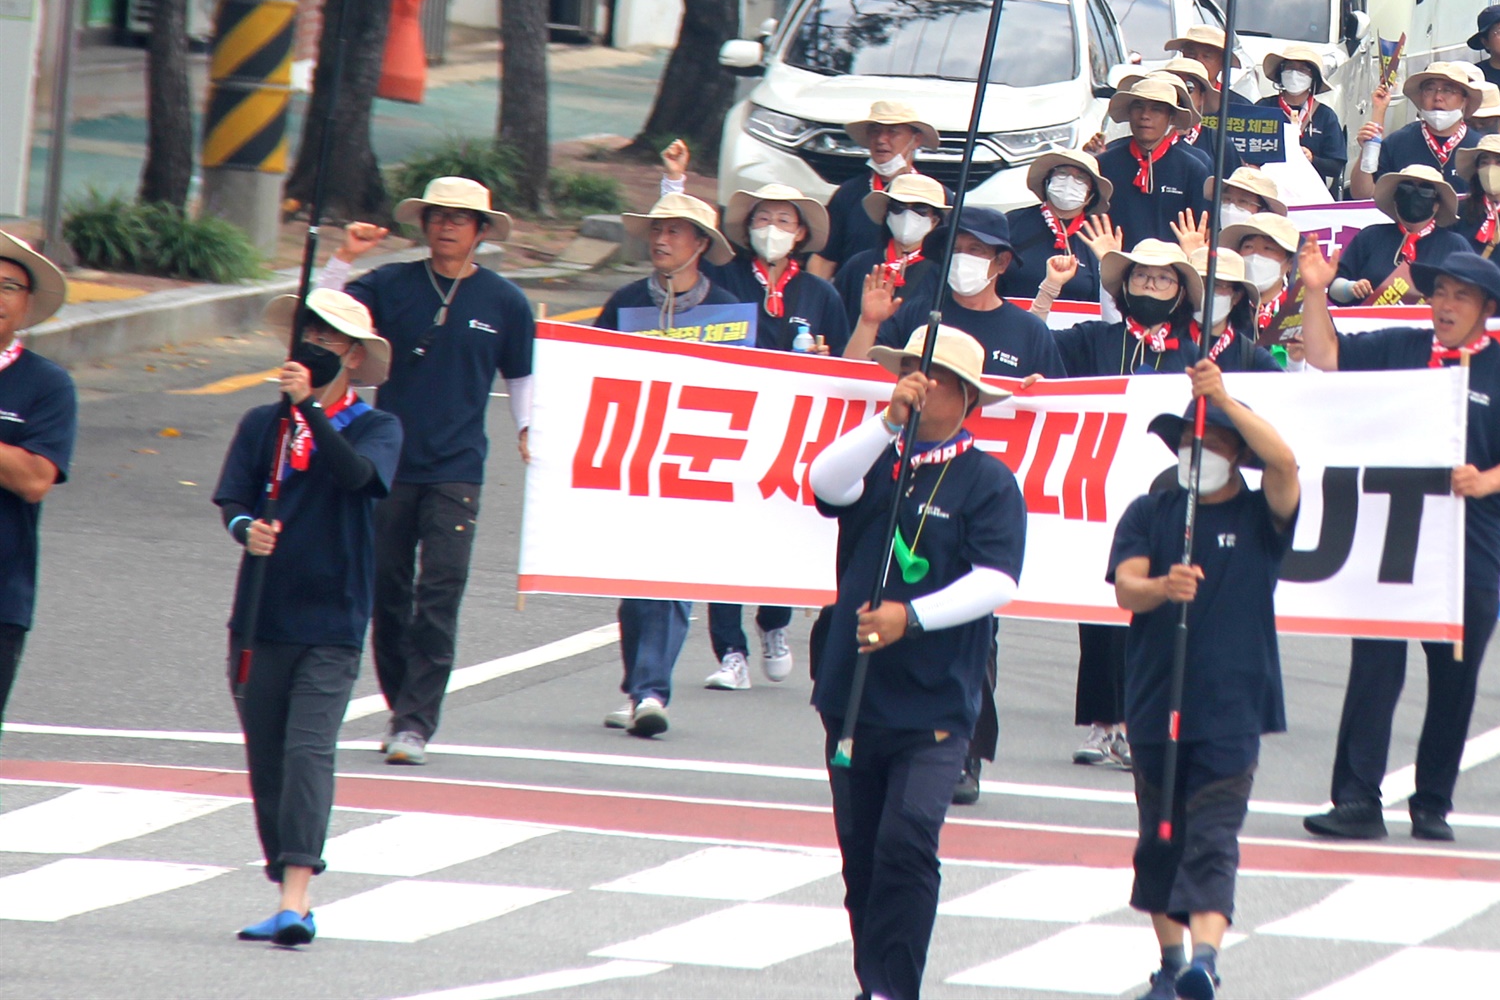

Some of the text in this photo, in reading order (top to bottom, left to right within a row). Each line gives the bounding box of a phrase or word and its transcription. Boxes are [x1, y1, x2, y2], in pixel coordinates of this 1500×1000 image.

[1247, 119, 1278, 134] 체결!
[1248, 138, 1278, 153] 철수!
[702, 321, 749, 343] 체결!
[570, 376, 759, 503] 미군
